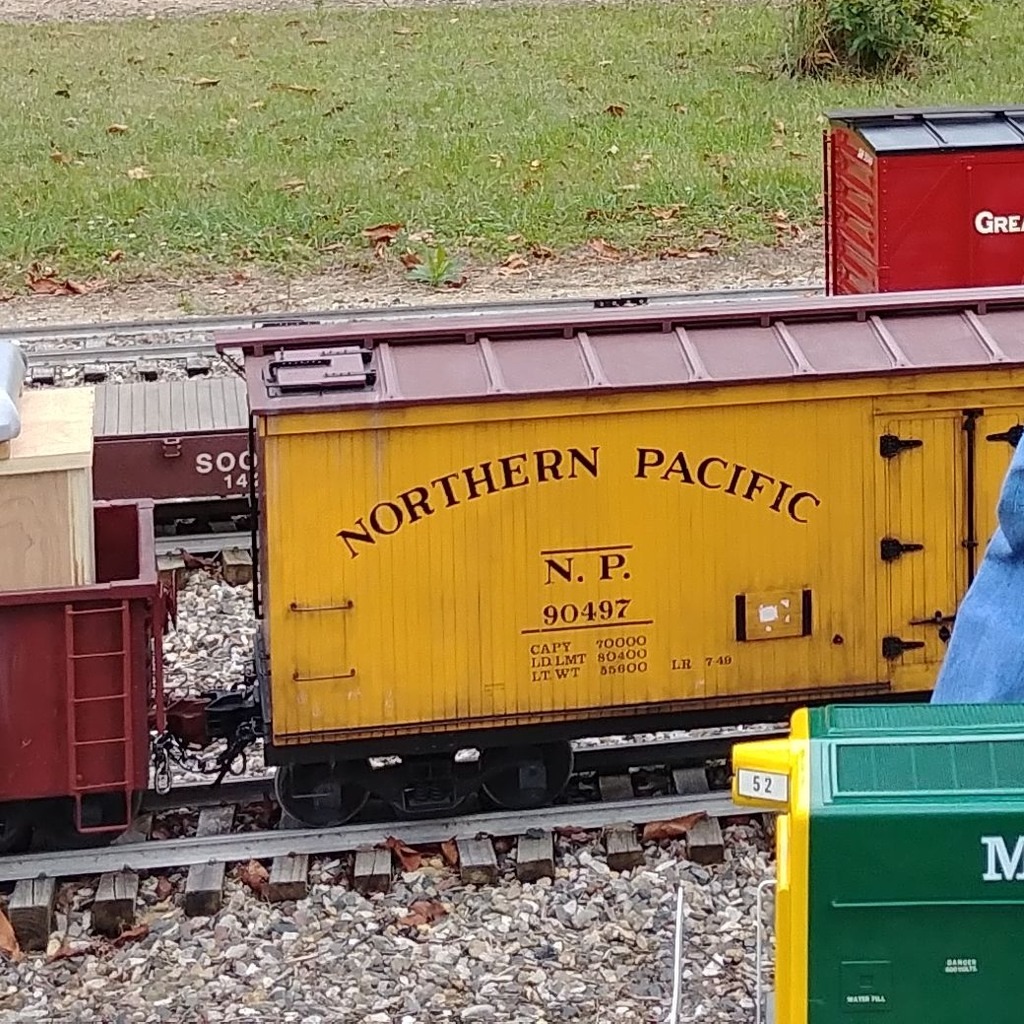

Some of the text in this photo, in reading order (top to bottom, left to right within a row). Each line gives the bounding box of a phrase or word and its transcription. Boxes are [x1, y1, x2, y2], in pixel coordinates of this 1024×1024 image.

[224, 473, 259, 489] 14
[336, 446, 821, 559] NORTHERN PACIFIC
[545, 554, 631, 585] N. P.
[543, 599, 632, 626] 90497
[530, 635, 647, 655] CAPY 70000
[532, 656, 551, 668] LD
[555, 653, 587, 666] LMT
[672, 659, 692, 670] LR
[532, 670, 550, 682] LT
[555, 667, 580, 679] WT
